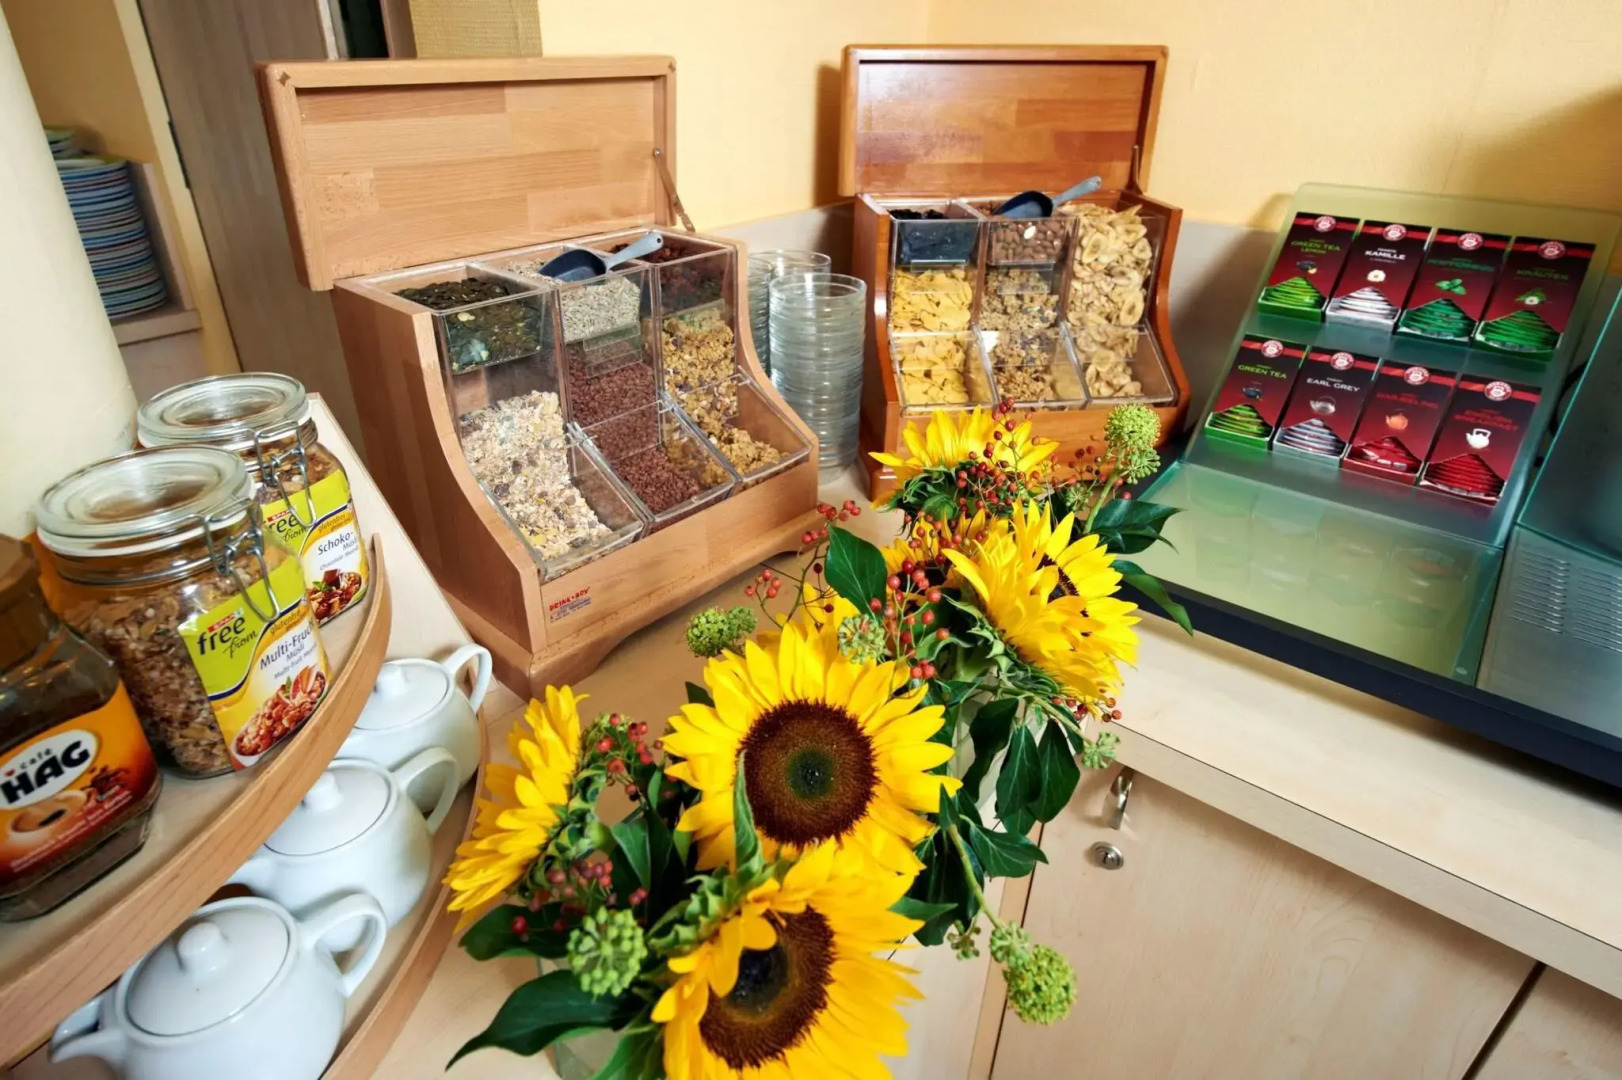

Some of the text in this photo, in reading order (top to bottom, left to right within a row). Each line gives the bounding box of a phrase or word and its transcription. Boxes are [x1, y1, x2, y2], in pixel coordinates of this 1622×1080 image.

[1291, 240, 1321, 249] GREEN
[1324, 244, 1340, 252] TEA
[1364, 249, 1406, 260] KAMILLE
[1237, 364, 1287, 379] GREEN TEA
[1306, 377, 1360, 392] EARL GREY
[317, 531, 354, 556] Schoko-
[196, 617, 246, 656] free
[222, 629, 257, 659] from
[0, 740, 90, 805] HAG
